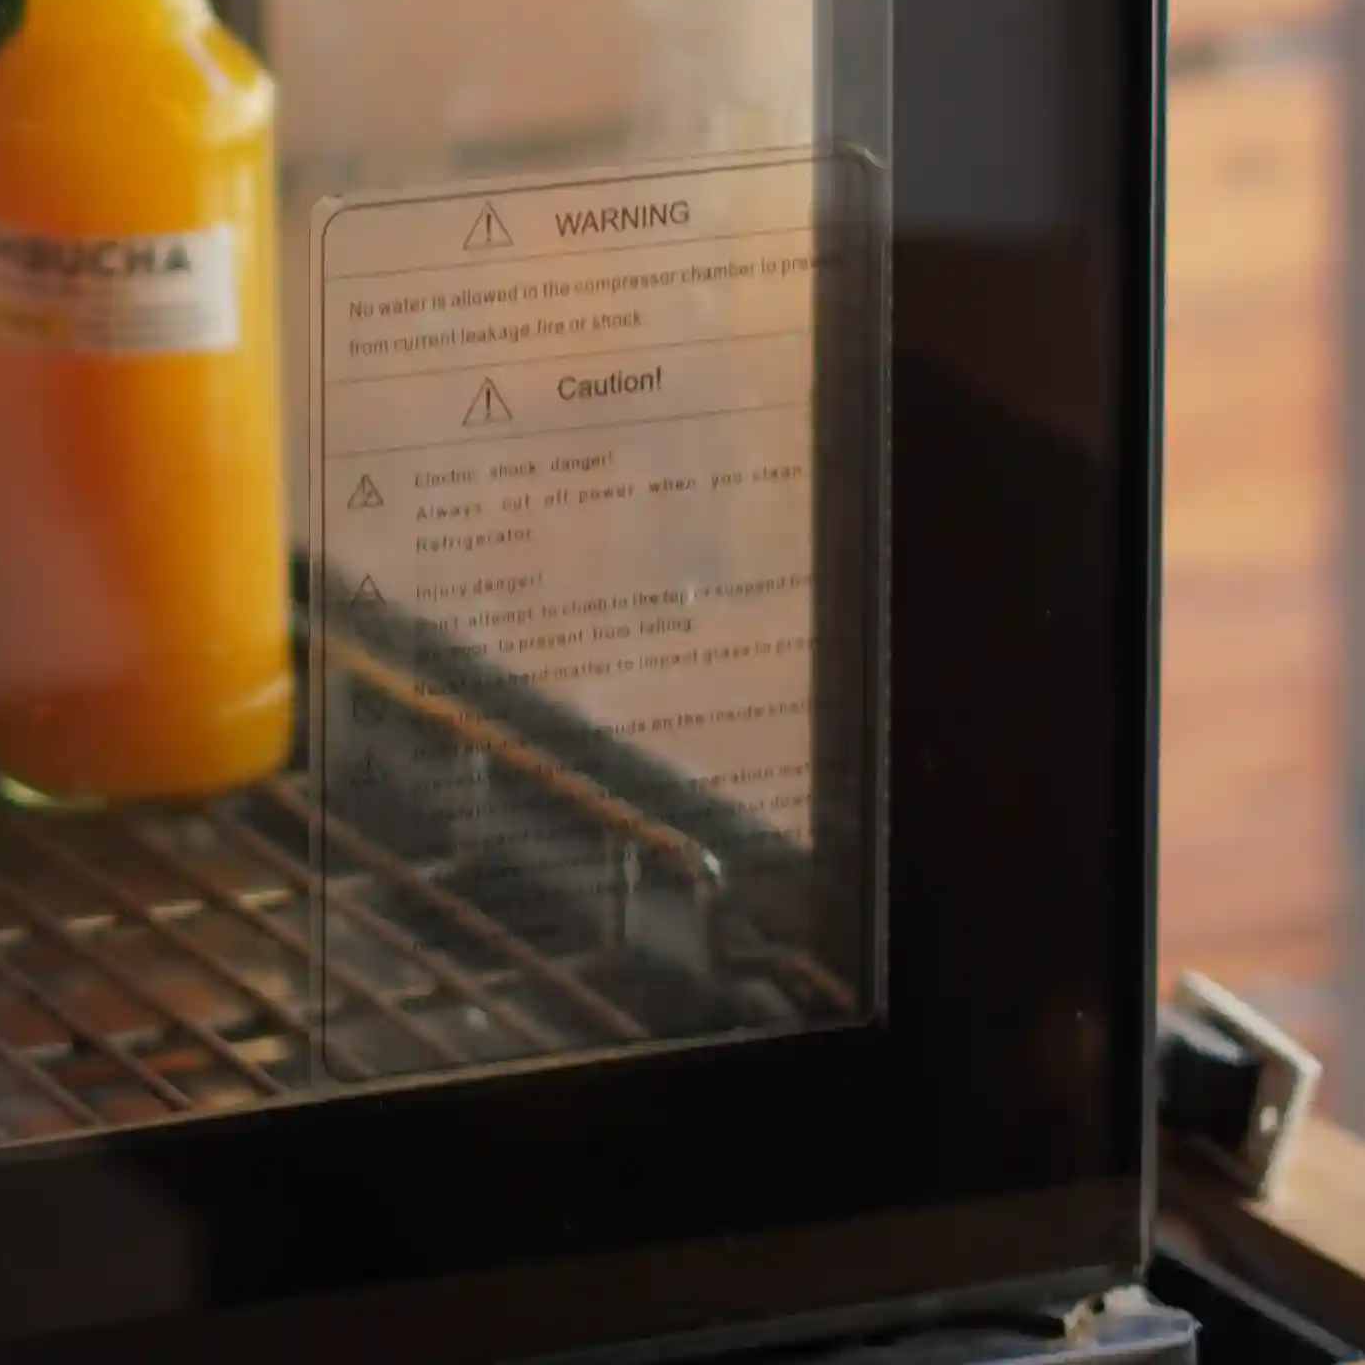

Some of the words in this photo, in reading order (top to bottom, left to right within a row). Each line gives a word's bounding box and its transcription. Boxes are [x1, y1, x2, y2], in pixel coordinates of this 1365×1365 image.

[555, 200, 690, 237] WARNING
[349, 301, 373, 318] No
[379, 297, 426, 315] water
[432, 296, 445, 311] is
[451, 284, 517, 308] allowed
[523, 284, 537, 300] in
[543, 280, 569, 298] the
[574, 270, 676, 294] compressor
[681, 259, 755, 284] chamber
[761, 258, 777, 274] to
[349, 338, 388, 358] from
[394, 329, 455, 352] current
[461, 322, 530, 343] leakage
[537, 318, 565, 335] fire
[569, 319, 587, 332] or
[557, 365, 662, 400] Caution!
[415, 468, 475, 488] Electric
[488, 460, 536, 479] shock
[550, 450, 613, 472] danger!
[416, 502, 482, 521] Always
[501, 493, 530, 512] cut
[544, 489, 568, 507] off
[578, 483, 635, 504] power
[648, 476, 697, 494] when
[711, 471, 743, 490] you
[753, 465, 803, 483] clean
[416, 527, 533, 554] Refrigerator
[416, 582, 467, 602] Injury
[472, 571, 543, 595] danger!
[469, 607, 532, 627] attempt
[542, 604, 557, 618] to
[612, 594, 628, 608] to
[633, 590, 658, 606] the
[715, 576, 785, 597] suspend
[499, 639, 515, 653] to
[520, 629, 583, 653] prevent
[592, 624, 630, 641] from
[617, 657, 634, 671] to
[639, 650, 697, 671] impact
[755, 640, 771, 654] to
[677, 713, 704, 728] the
